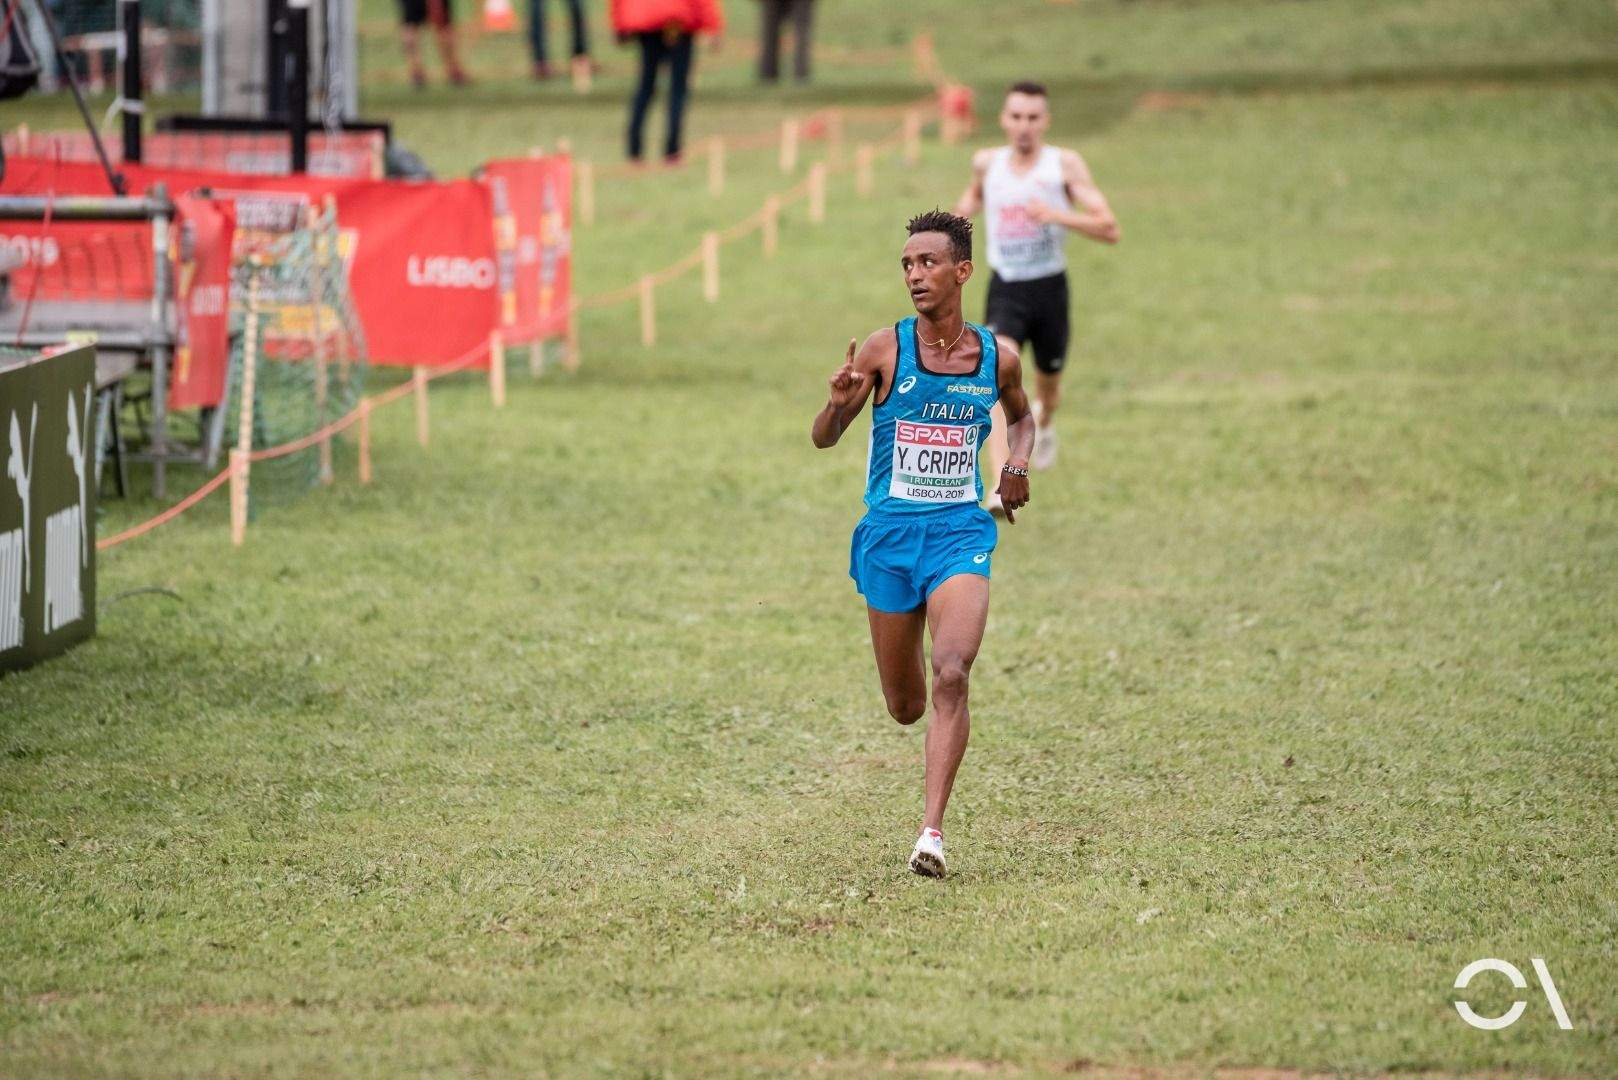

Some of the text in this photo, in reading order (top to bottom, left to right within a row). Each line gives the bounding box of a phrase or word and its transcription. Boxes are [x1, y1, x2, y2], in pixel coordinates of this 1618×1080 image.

[922, 402, 974, 421] ITALIA
[899, 425, 963, 444] SPAR
[898, 446, 974, 475] Y. CRIPPA
[914, 477, 933, 486] RUN
[906, 487, 965, 499] LISBOA 2019
